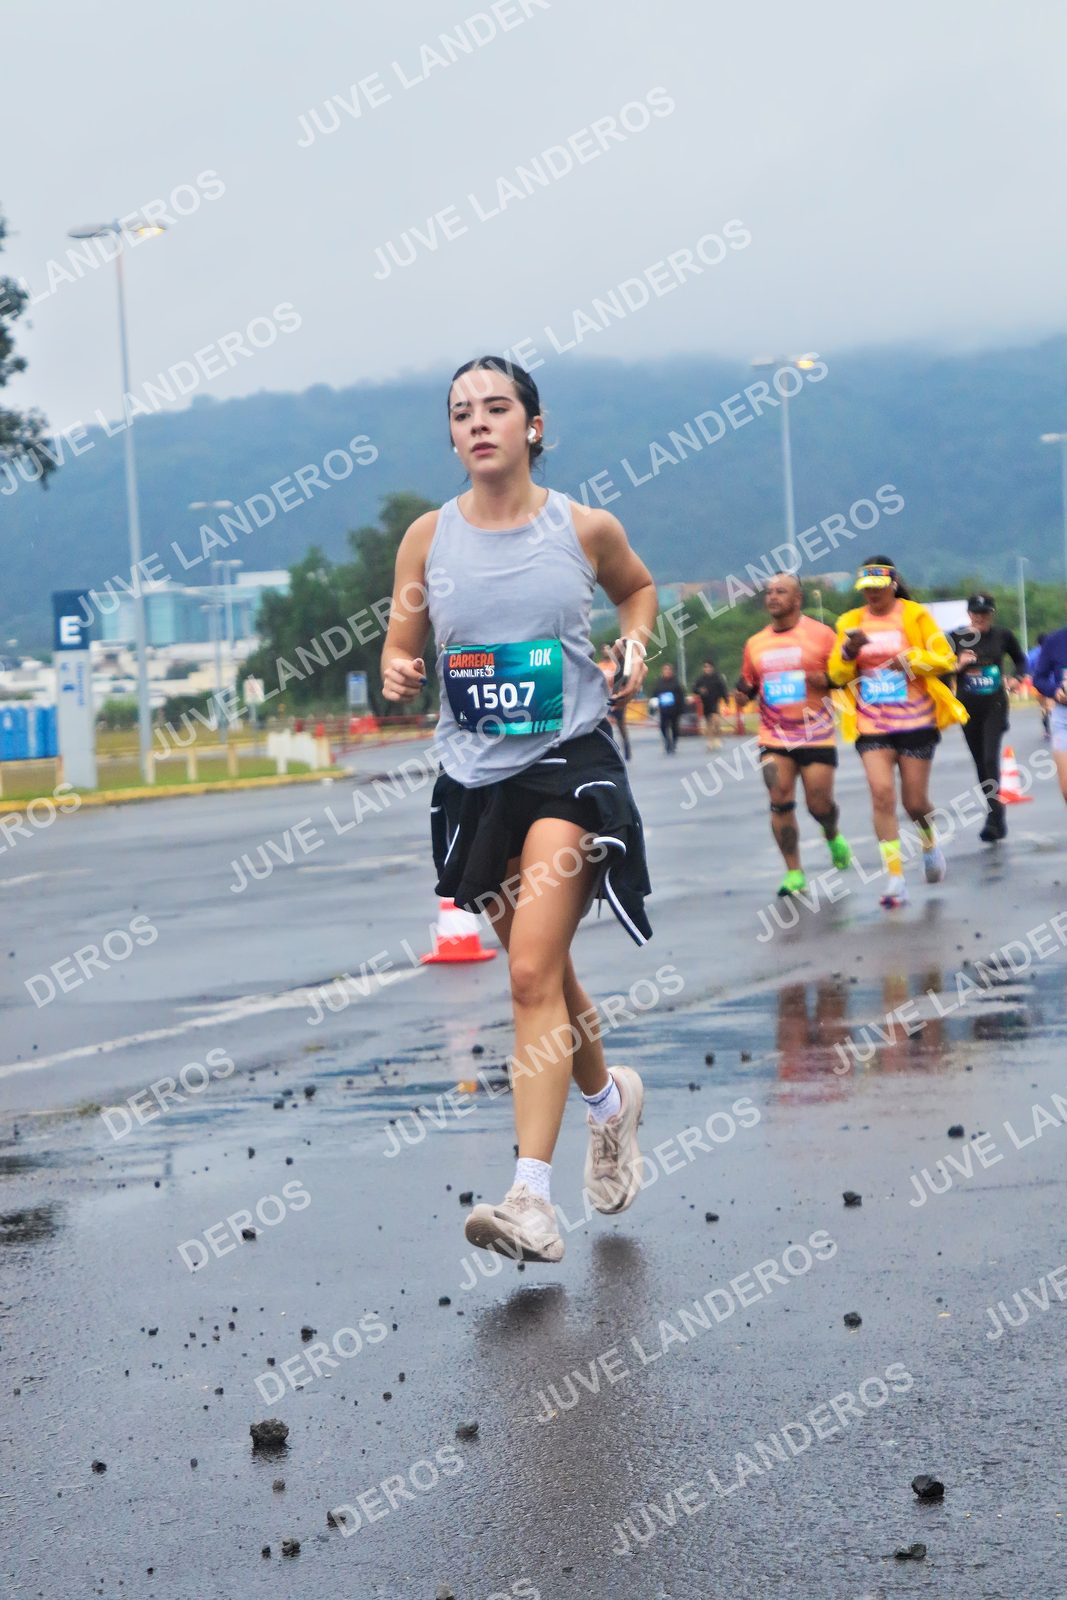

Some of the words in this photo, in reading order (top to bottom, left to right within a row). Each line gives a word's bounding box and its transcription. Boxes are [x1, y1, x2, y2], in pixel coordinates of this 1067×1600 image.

[60, 615, 81, 645] E
[449, 652, 494, 668] CARRERA
[529, 648, 552, 667] 10K
[449, 668, 485, 678] OMNILIFE
[467, 681, 535, 709] 1507
